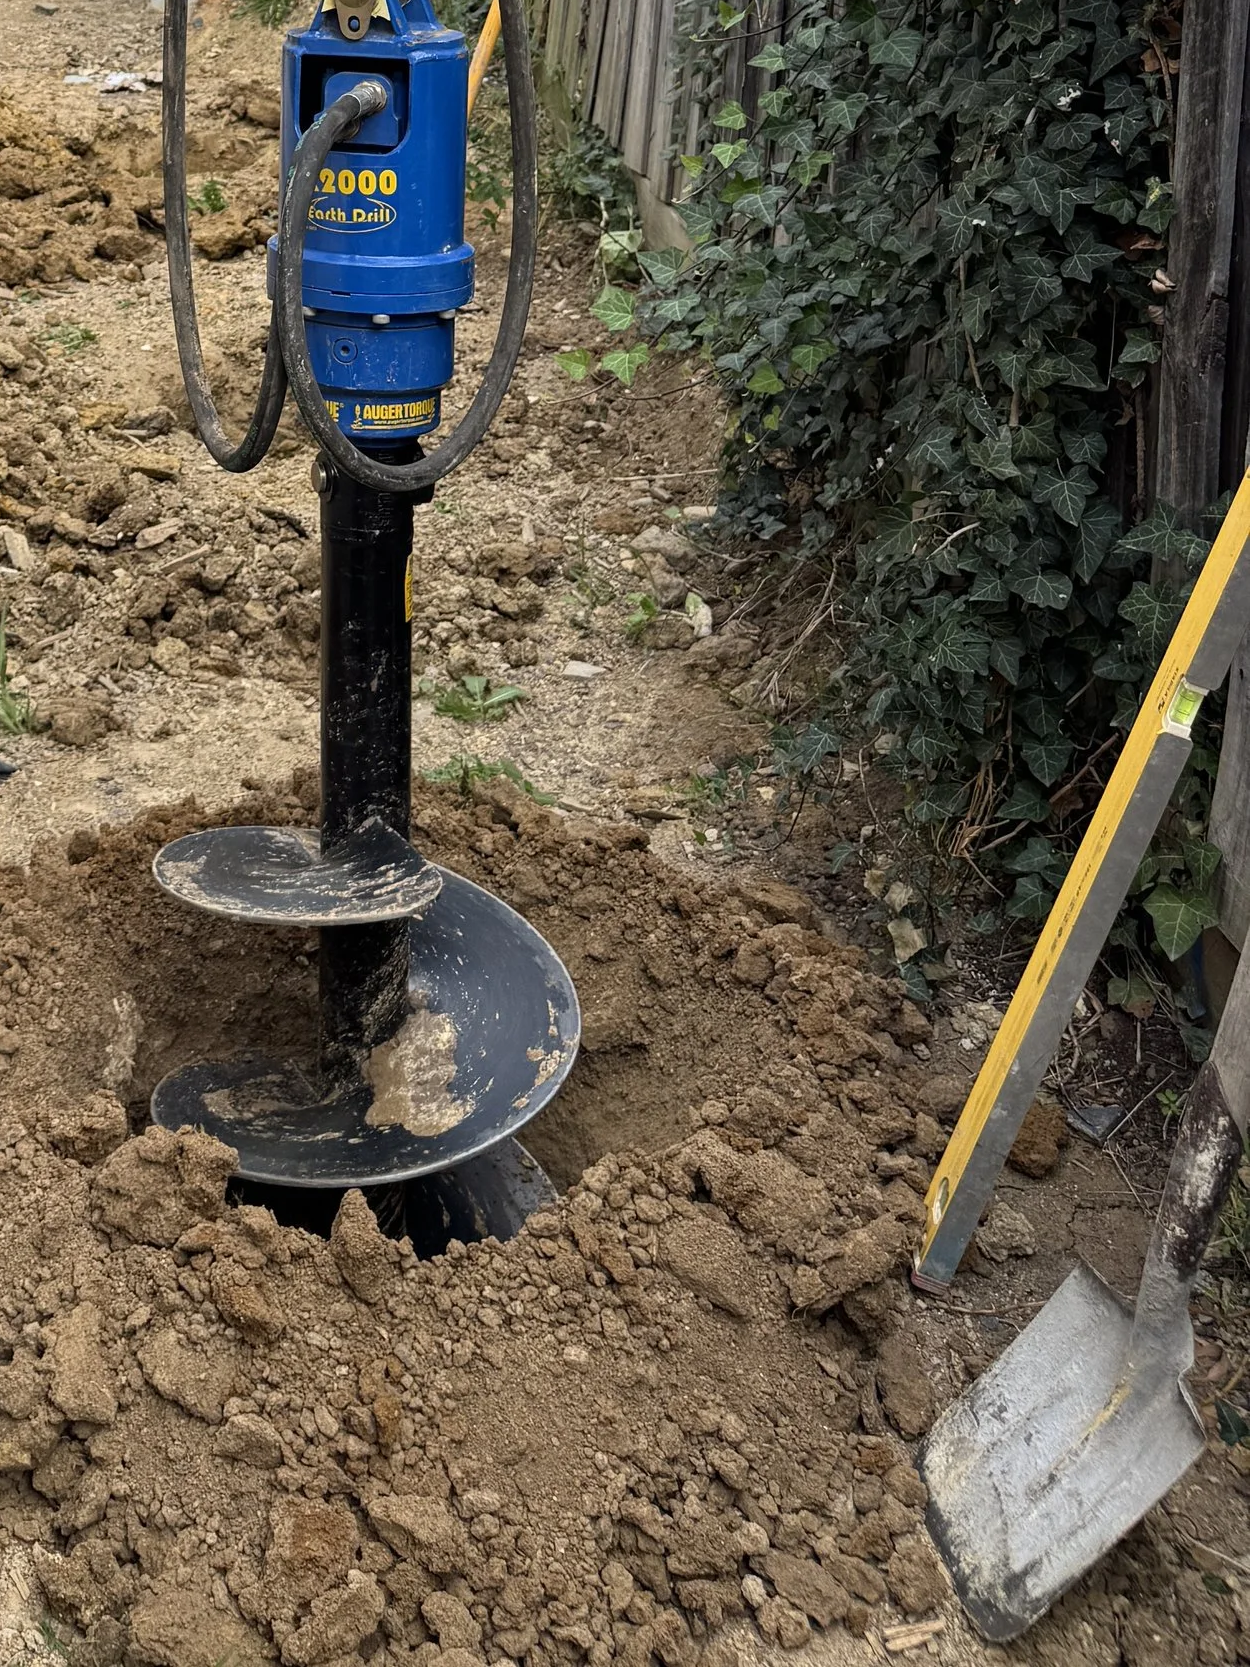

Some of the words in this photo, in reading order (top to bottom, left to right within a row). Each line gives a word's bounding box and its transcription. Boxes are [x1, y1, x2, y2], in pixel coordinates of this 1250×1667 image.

[314, 168, 397, 195] 2000
[308, 205, 347, 222] Earth
[353, 208, 390, 223] Drill
